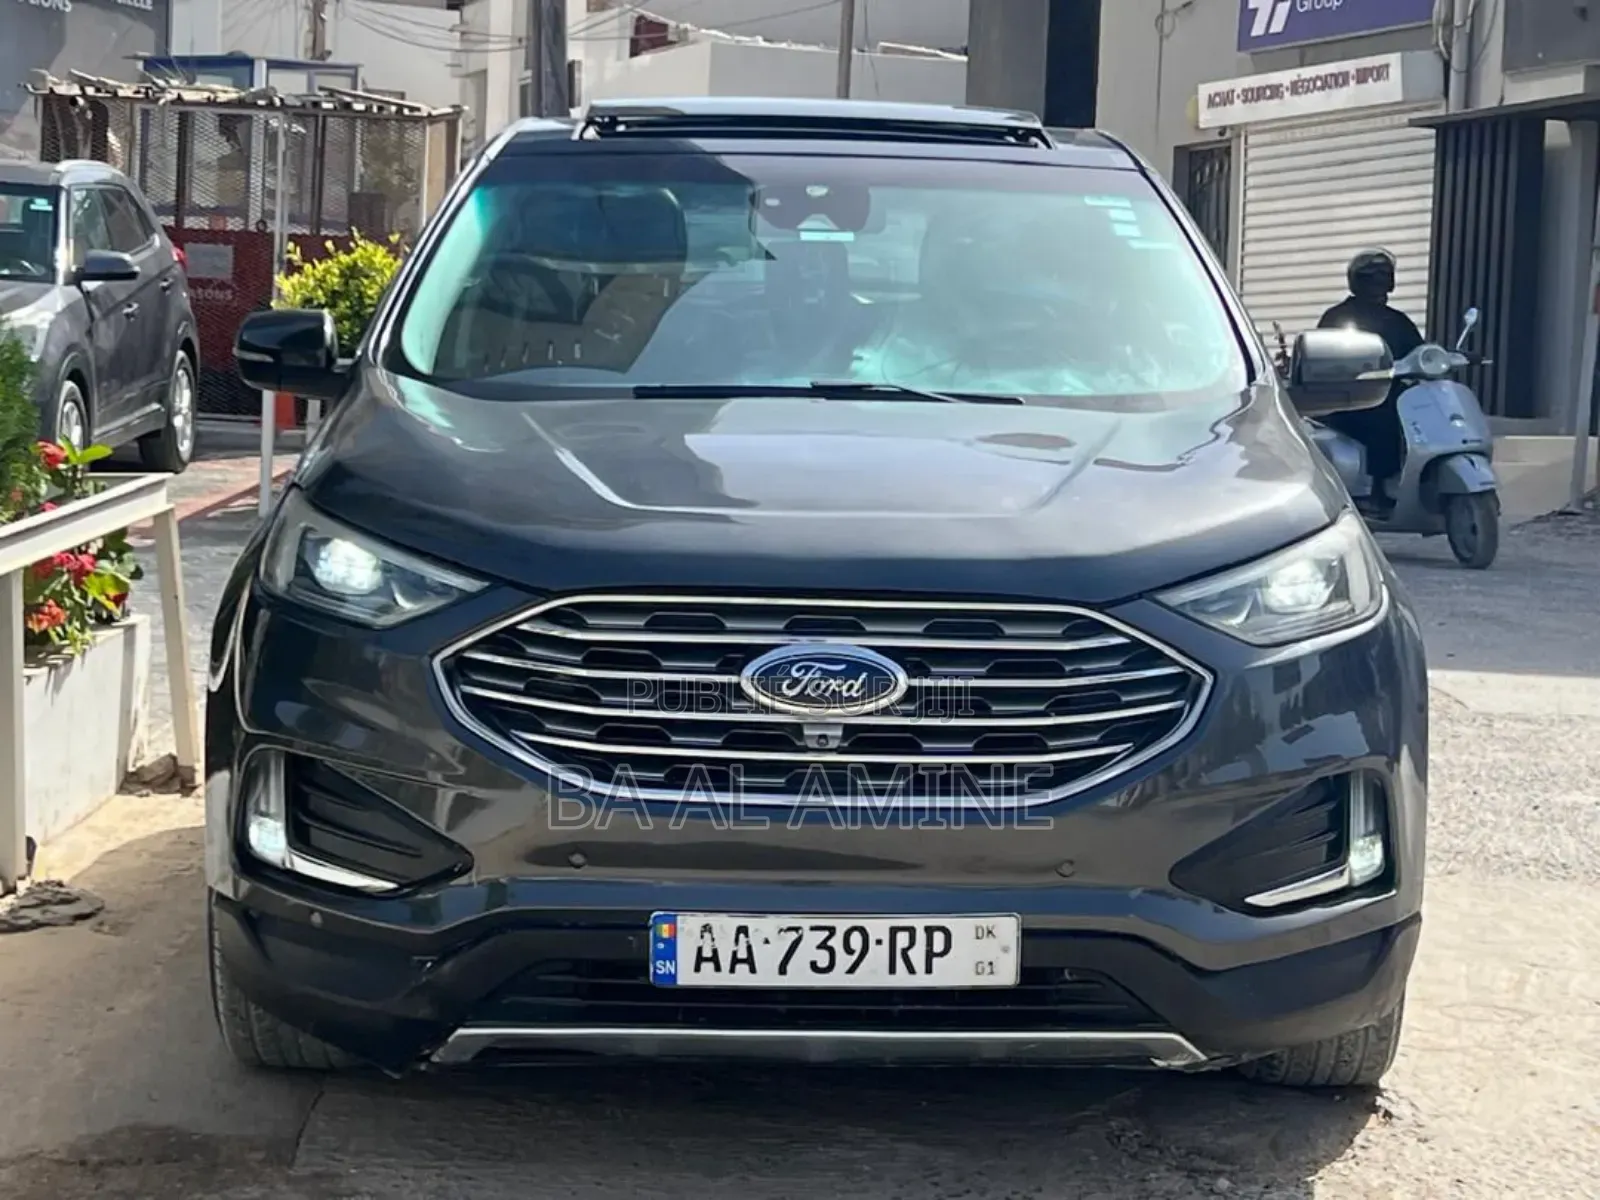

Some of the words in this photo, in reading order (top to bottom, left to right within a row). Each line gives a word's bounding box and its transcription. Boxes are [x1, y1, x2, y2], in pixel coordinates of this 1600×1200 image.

[1207, 88, 1236, 109] ACHAT
[1241, 83, 1285, 105] SOURCING
[1290, 71, 1351, 97] NÉGOCIATION
[1355, 63, 1391, 85] IMPORT
[781, 661, 869, 699] Ford
[974, 925, 997, 941] DK
[655, 960, 676, 975] SN
